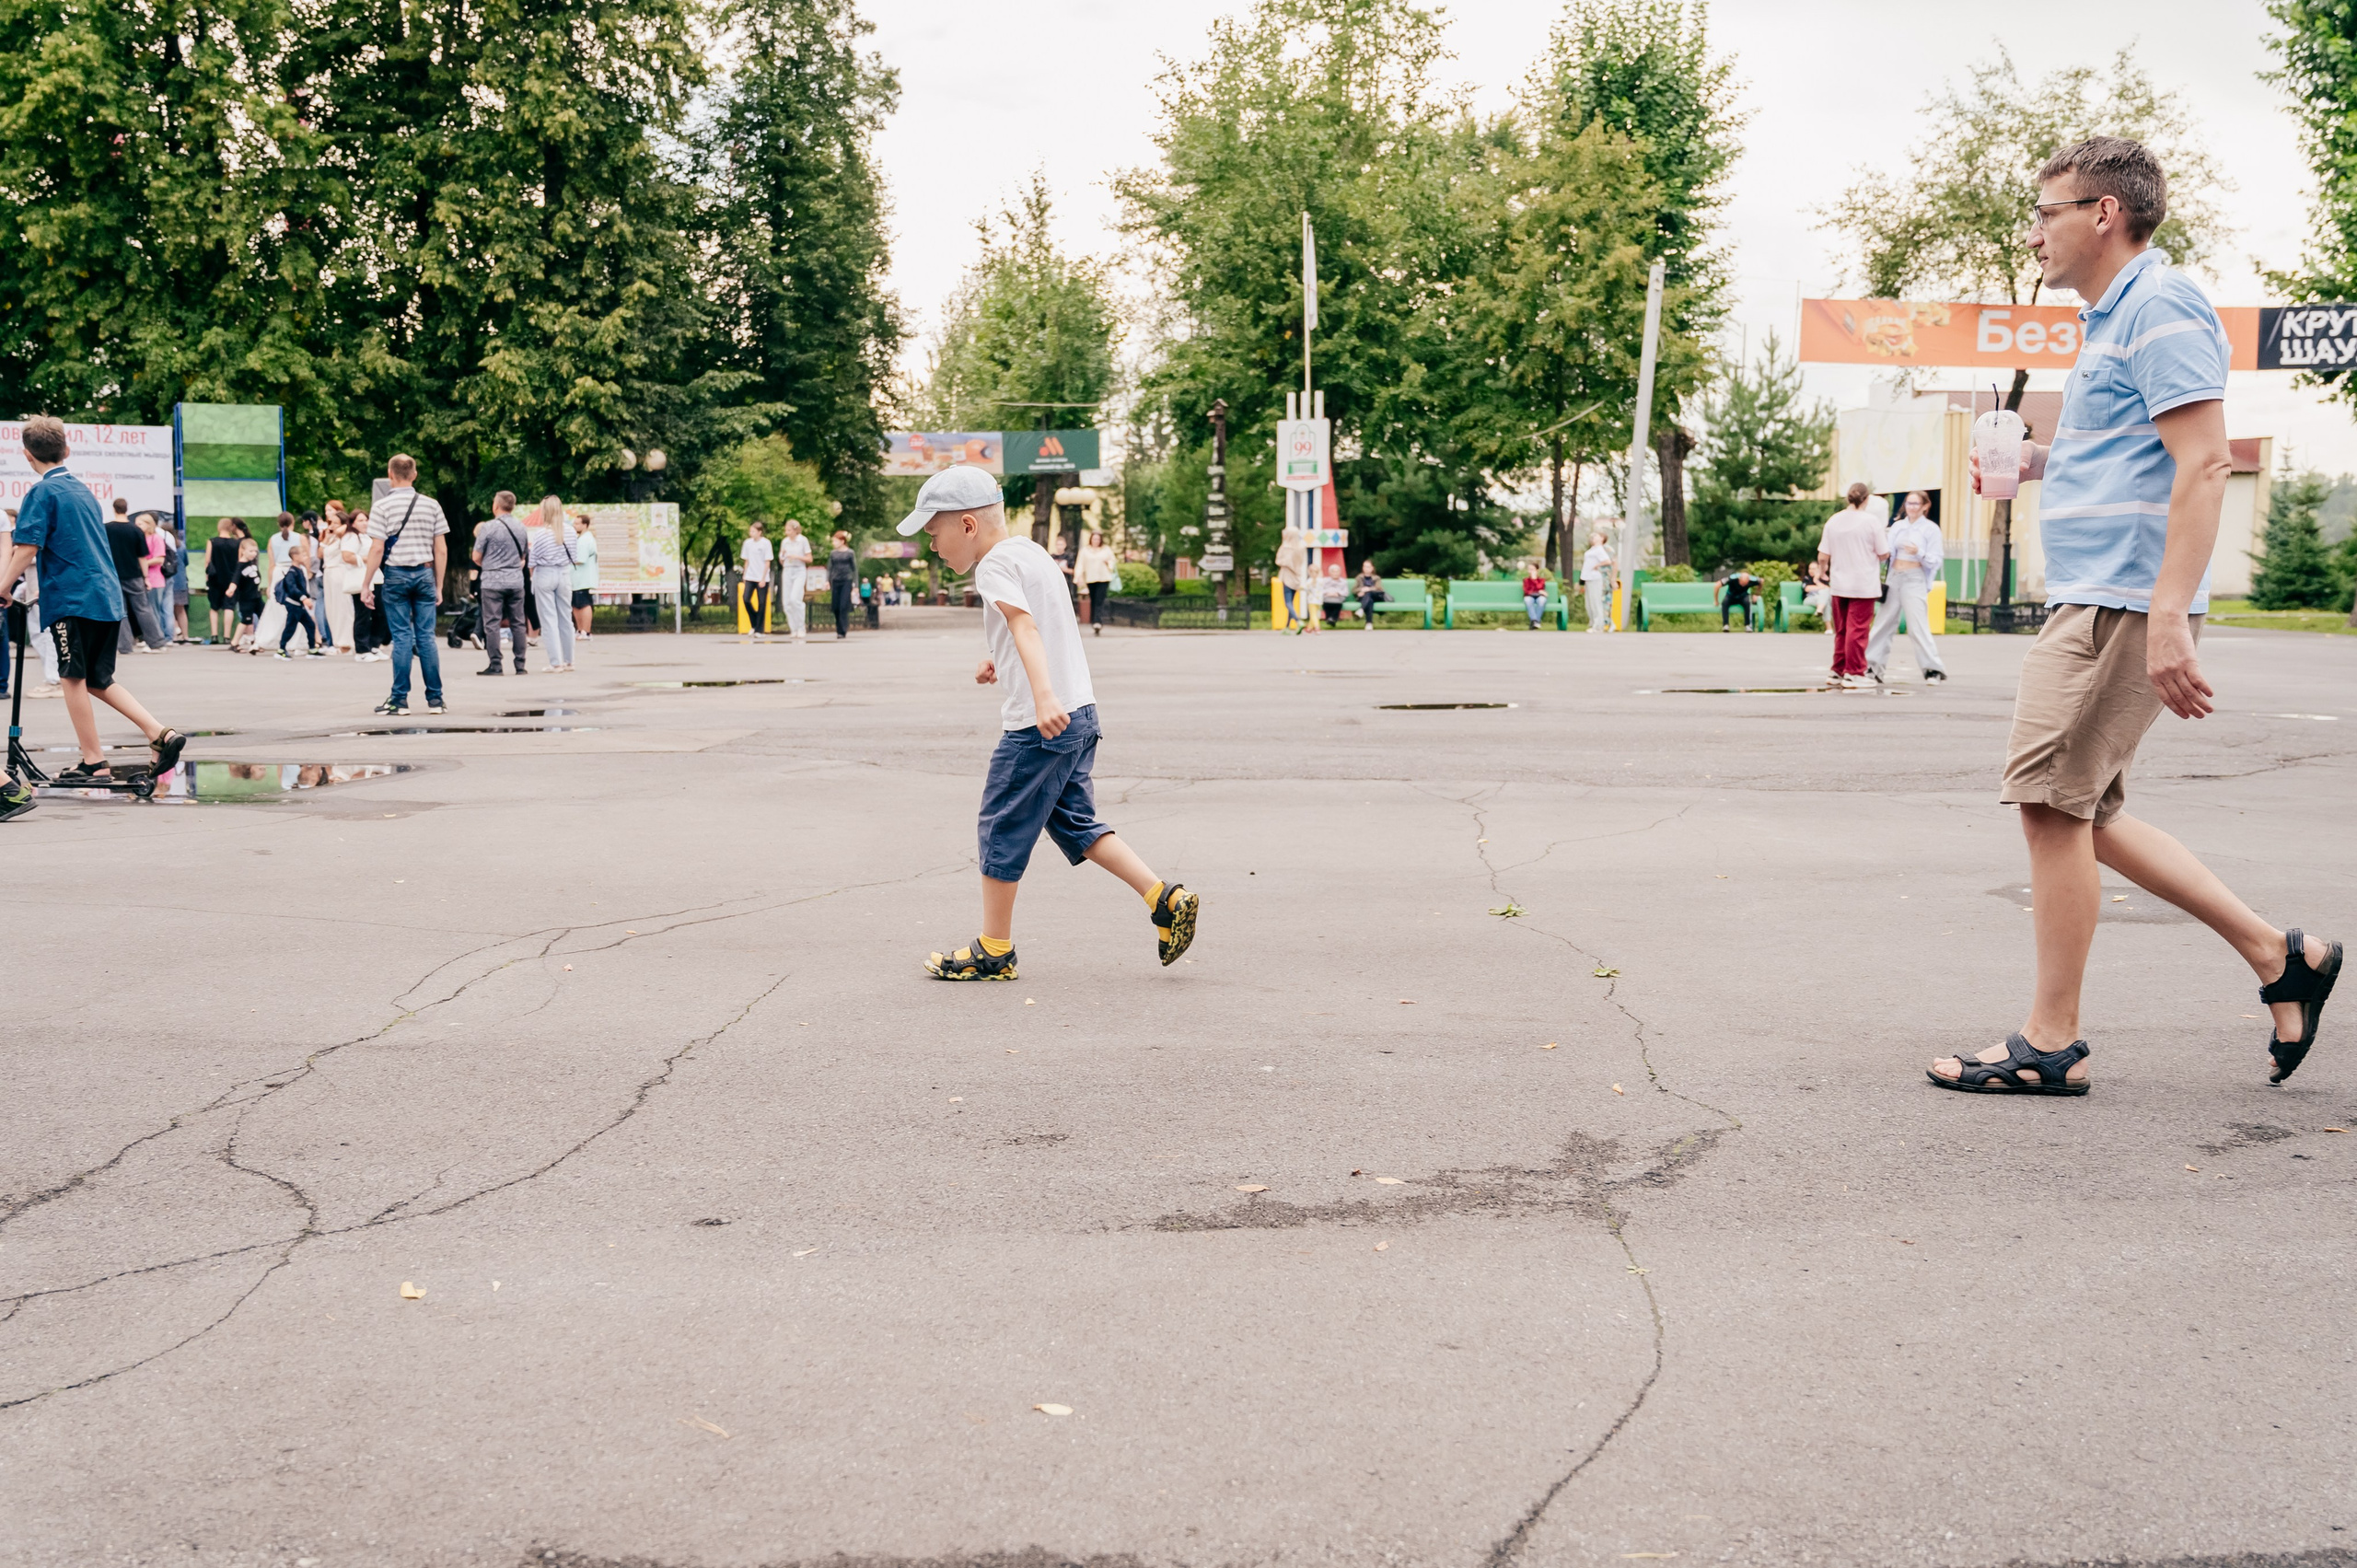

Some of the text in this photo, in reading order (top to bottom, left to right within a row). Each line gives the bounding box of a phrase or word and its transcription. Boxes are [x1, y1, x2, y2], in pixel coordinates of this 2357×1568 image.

[1977, 309, 2085, 354] Без
[2280, 338, 2357, 365] ШАУ
[0, 424, 146, 445] ов ил, 12 лет
[1295, 441, 1312, 456] 99
[56, 621, 71, 663] SPORT
